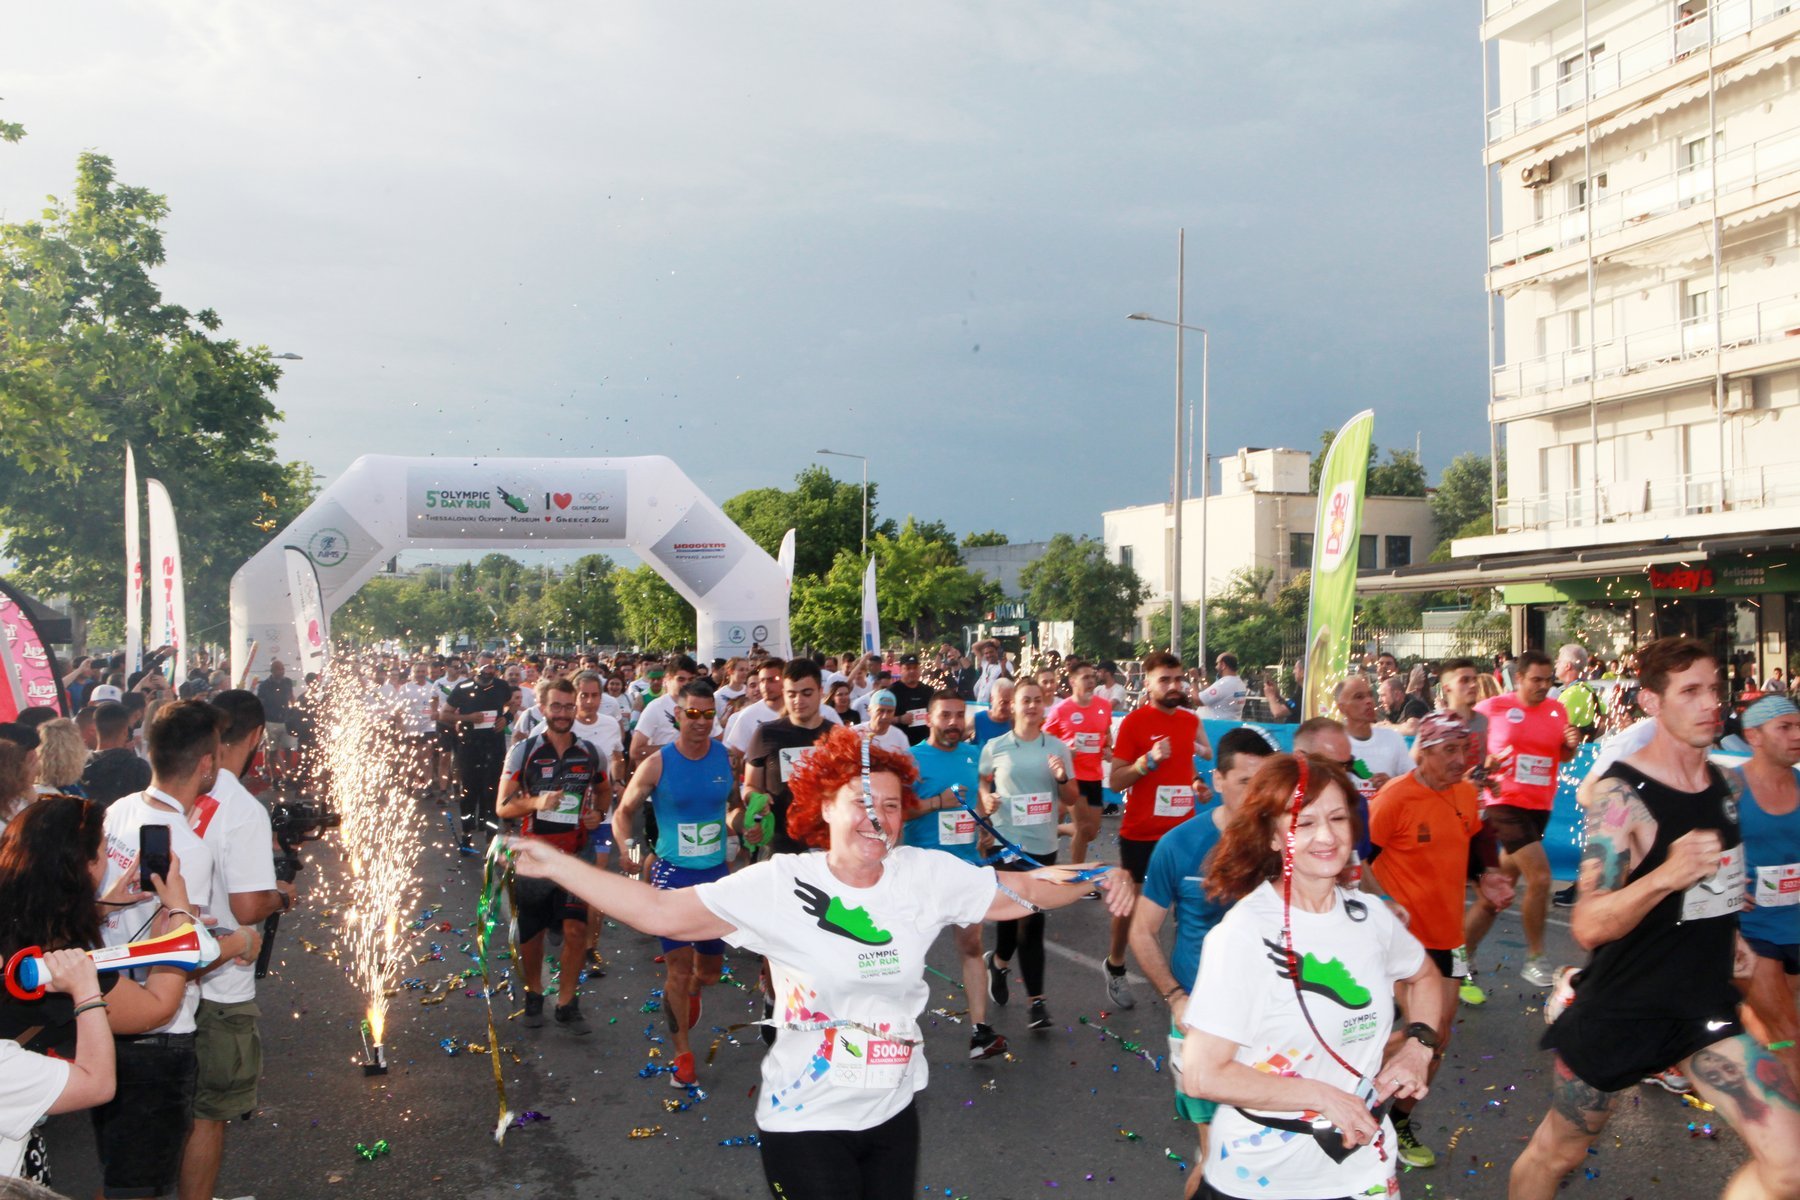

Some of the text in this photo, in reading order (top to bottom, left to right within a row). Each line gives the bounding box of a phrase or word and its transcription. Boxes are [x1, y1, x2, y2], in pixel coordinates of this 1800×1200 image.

[440, 490, 490, 500] OLYMPIC
[441, 500, 491, 509] DAY RUN
[1722, 567, 1765, 577] delicious
[1649, 563, 1713, 592] today's
[1734, 576, 1766, 586] stores
[858, 949, 899, 960] OLYMPIC
[858, 957, 899, 968] DAY RUN
[1343, 1011, 1377, 1028] OLYMPIC
[1359, 1020, 1377, 1030] RUN
[872, 1043, 910, 1057] 50040
